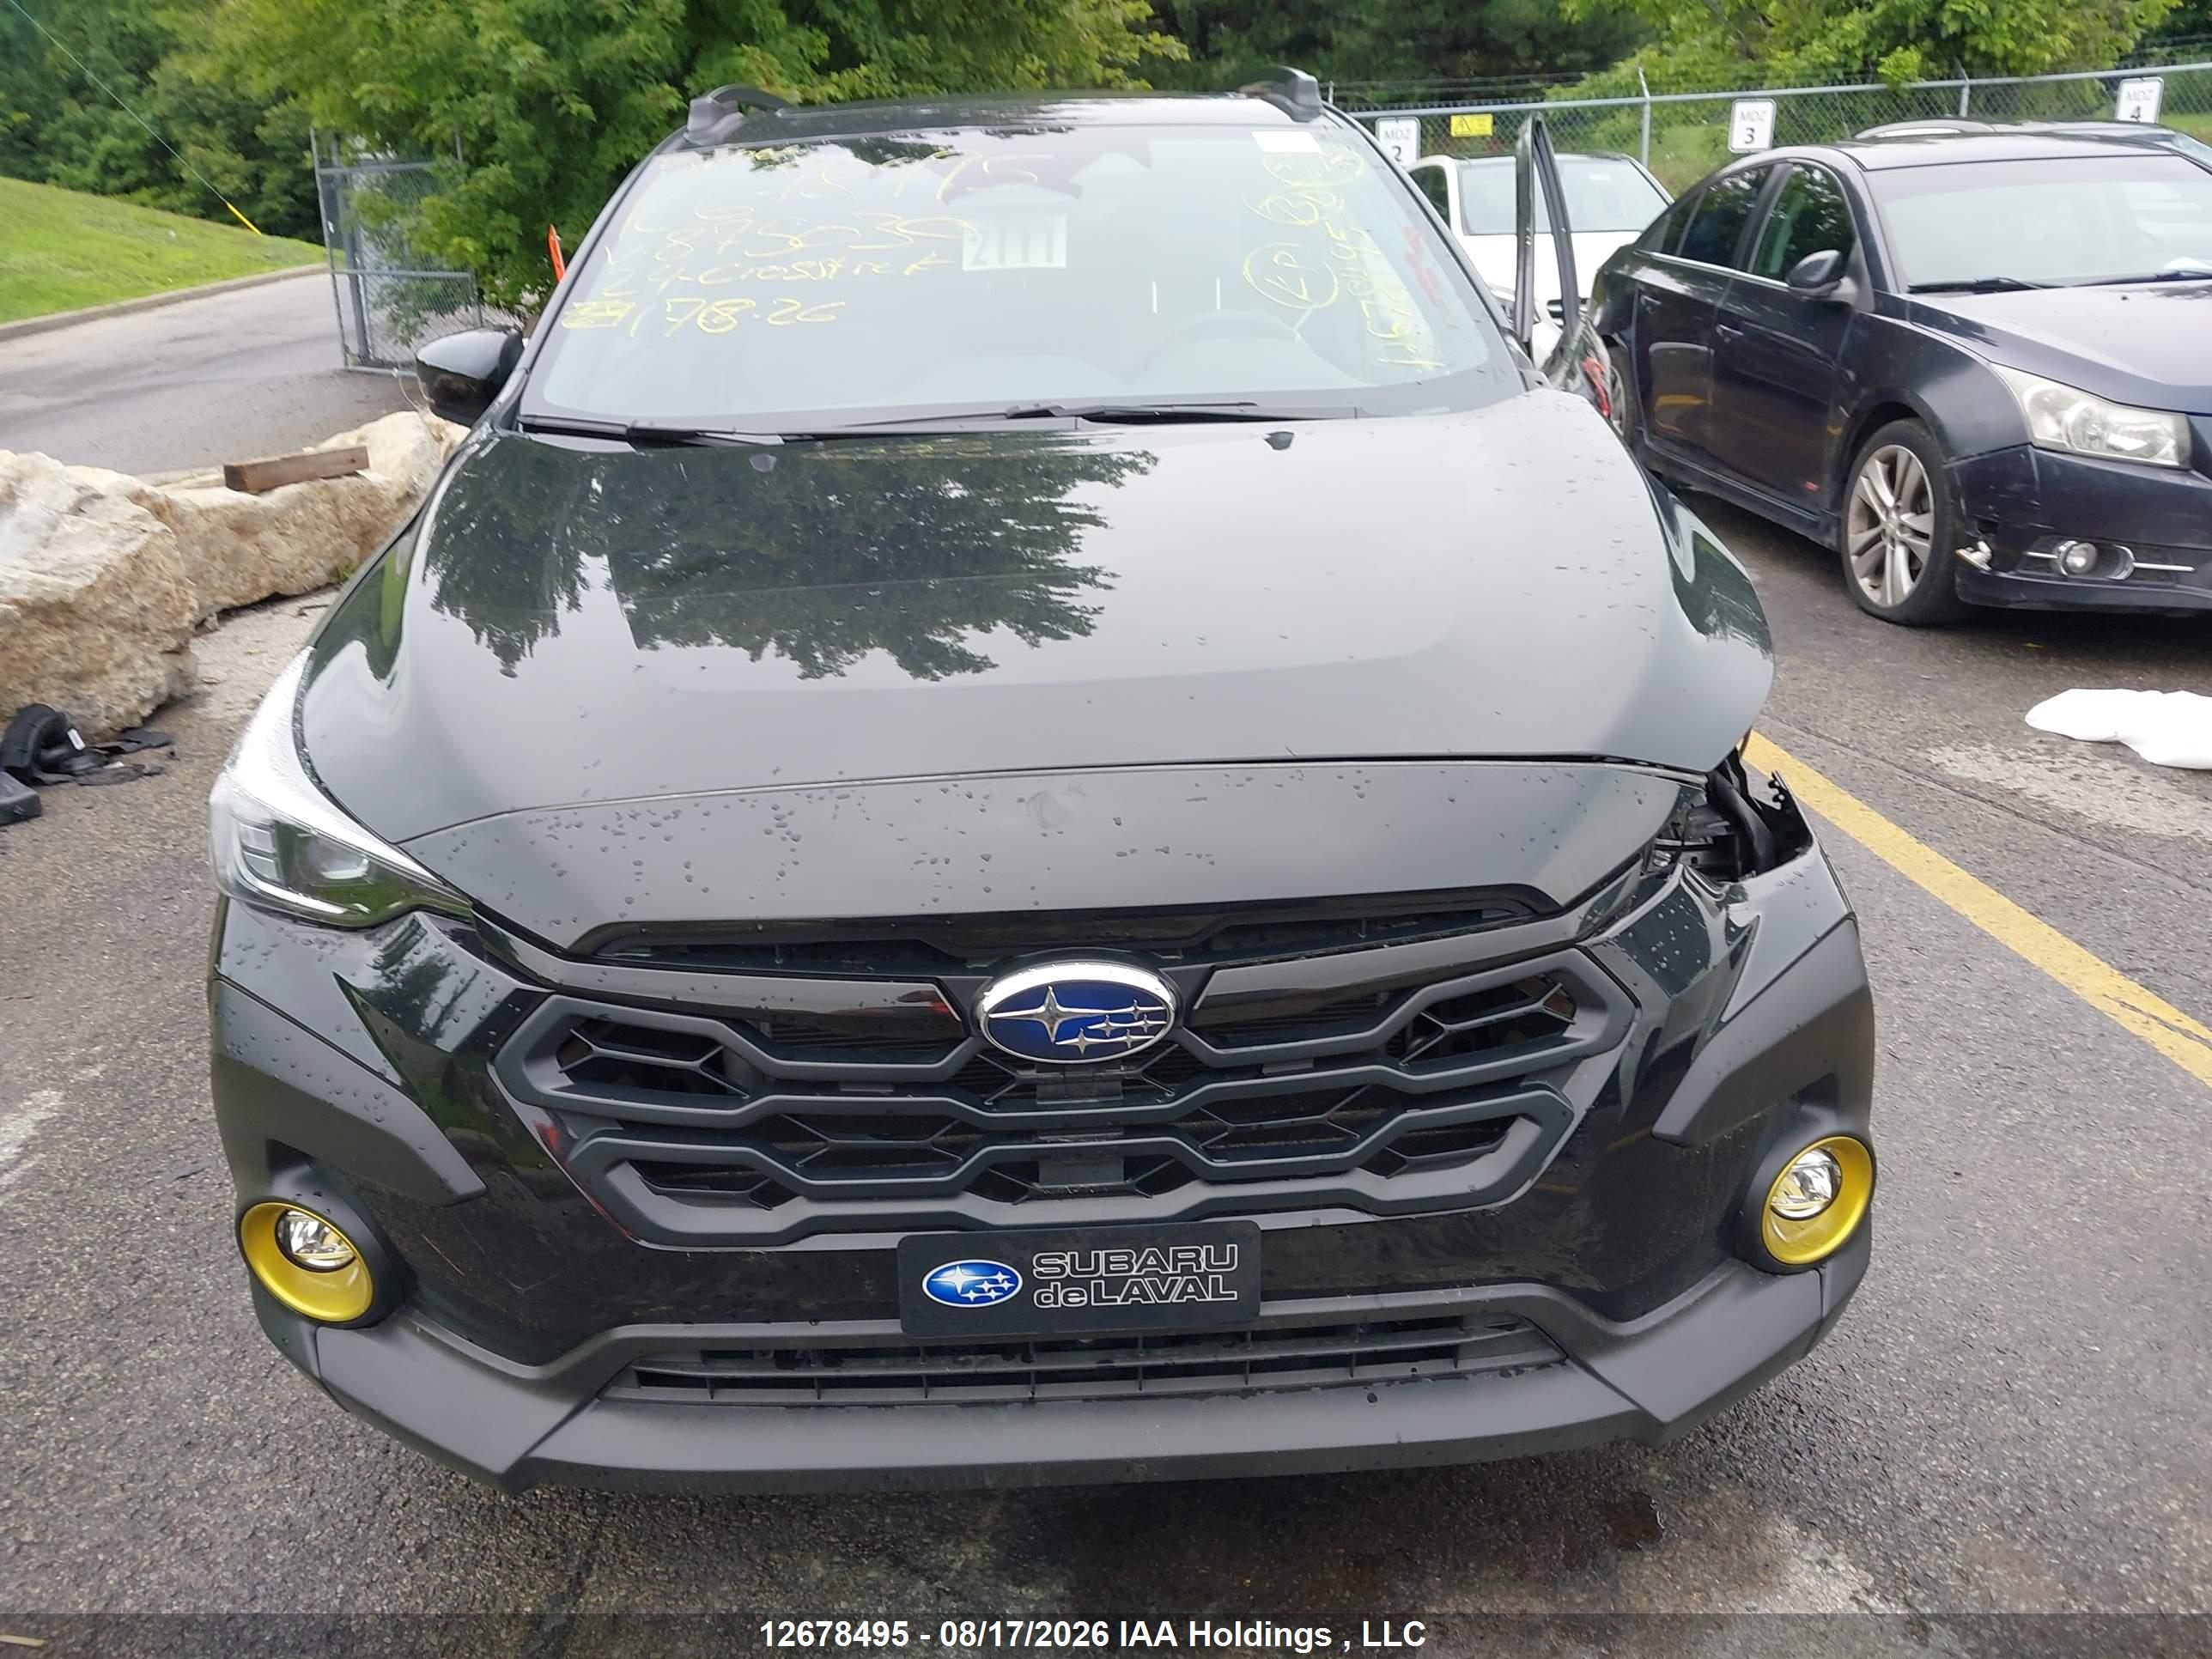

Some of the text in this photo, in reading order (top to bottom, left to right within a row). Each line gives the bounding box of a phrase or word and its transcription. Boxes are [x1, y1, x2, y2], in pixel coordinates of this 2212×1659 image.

[1744, 127, 1754, 144] 3
[1391, 145, 1402, 162] 2
[1032, 1243, 1238, 1279] SUBARU
